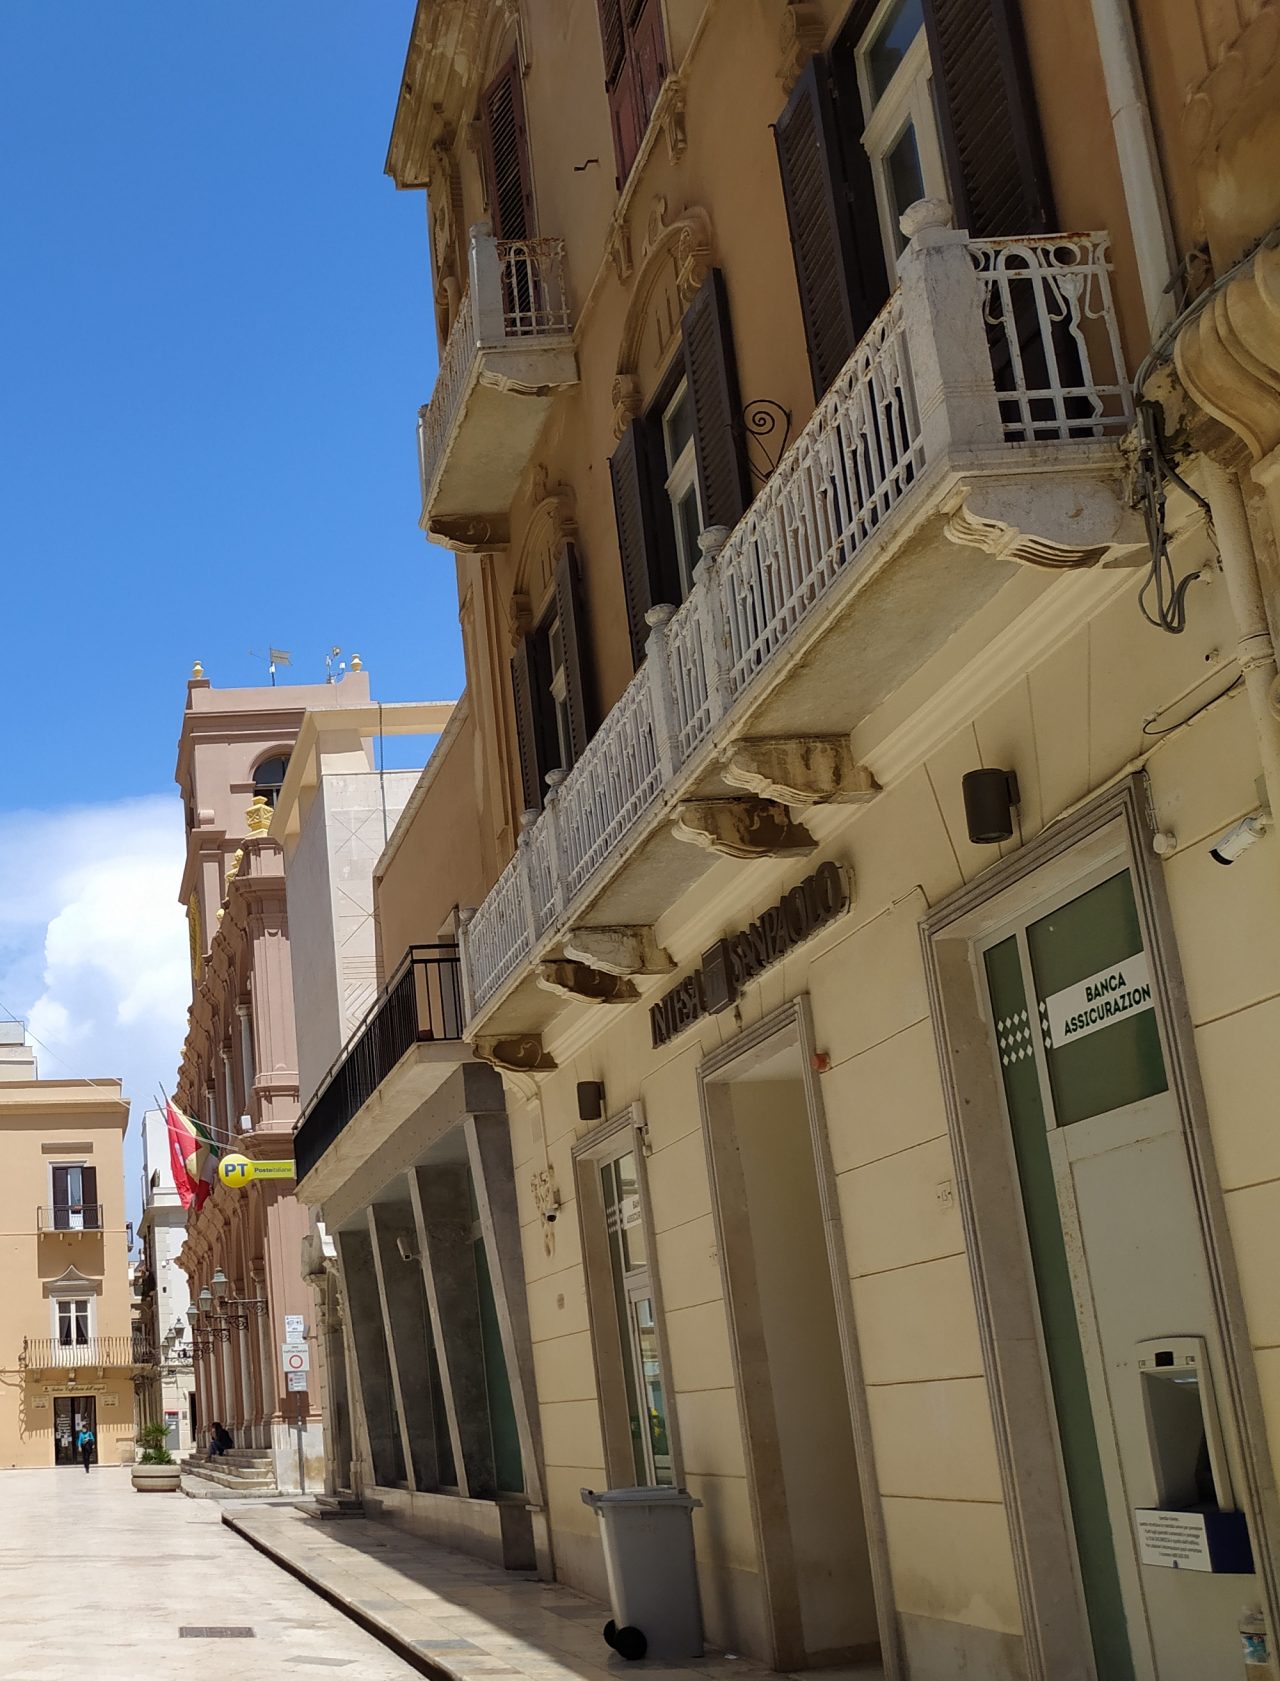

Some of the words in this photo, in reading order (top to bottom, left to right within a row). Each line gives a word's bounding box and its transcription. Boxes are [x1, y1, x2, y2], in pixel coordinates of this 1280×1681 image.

[728, 861, 843, 987] SANPAOLO
[1085, 971, 1127, 1003] BANCA
[1064, 983, 1152, 1036] ASSICURAZION
[224, 1163, 248, 1177] PT
